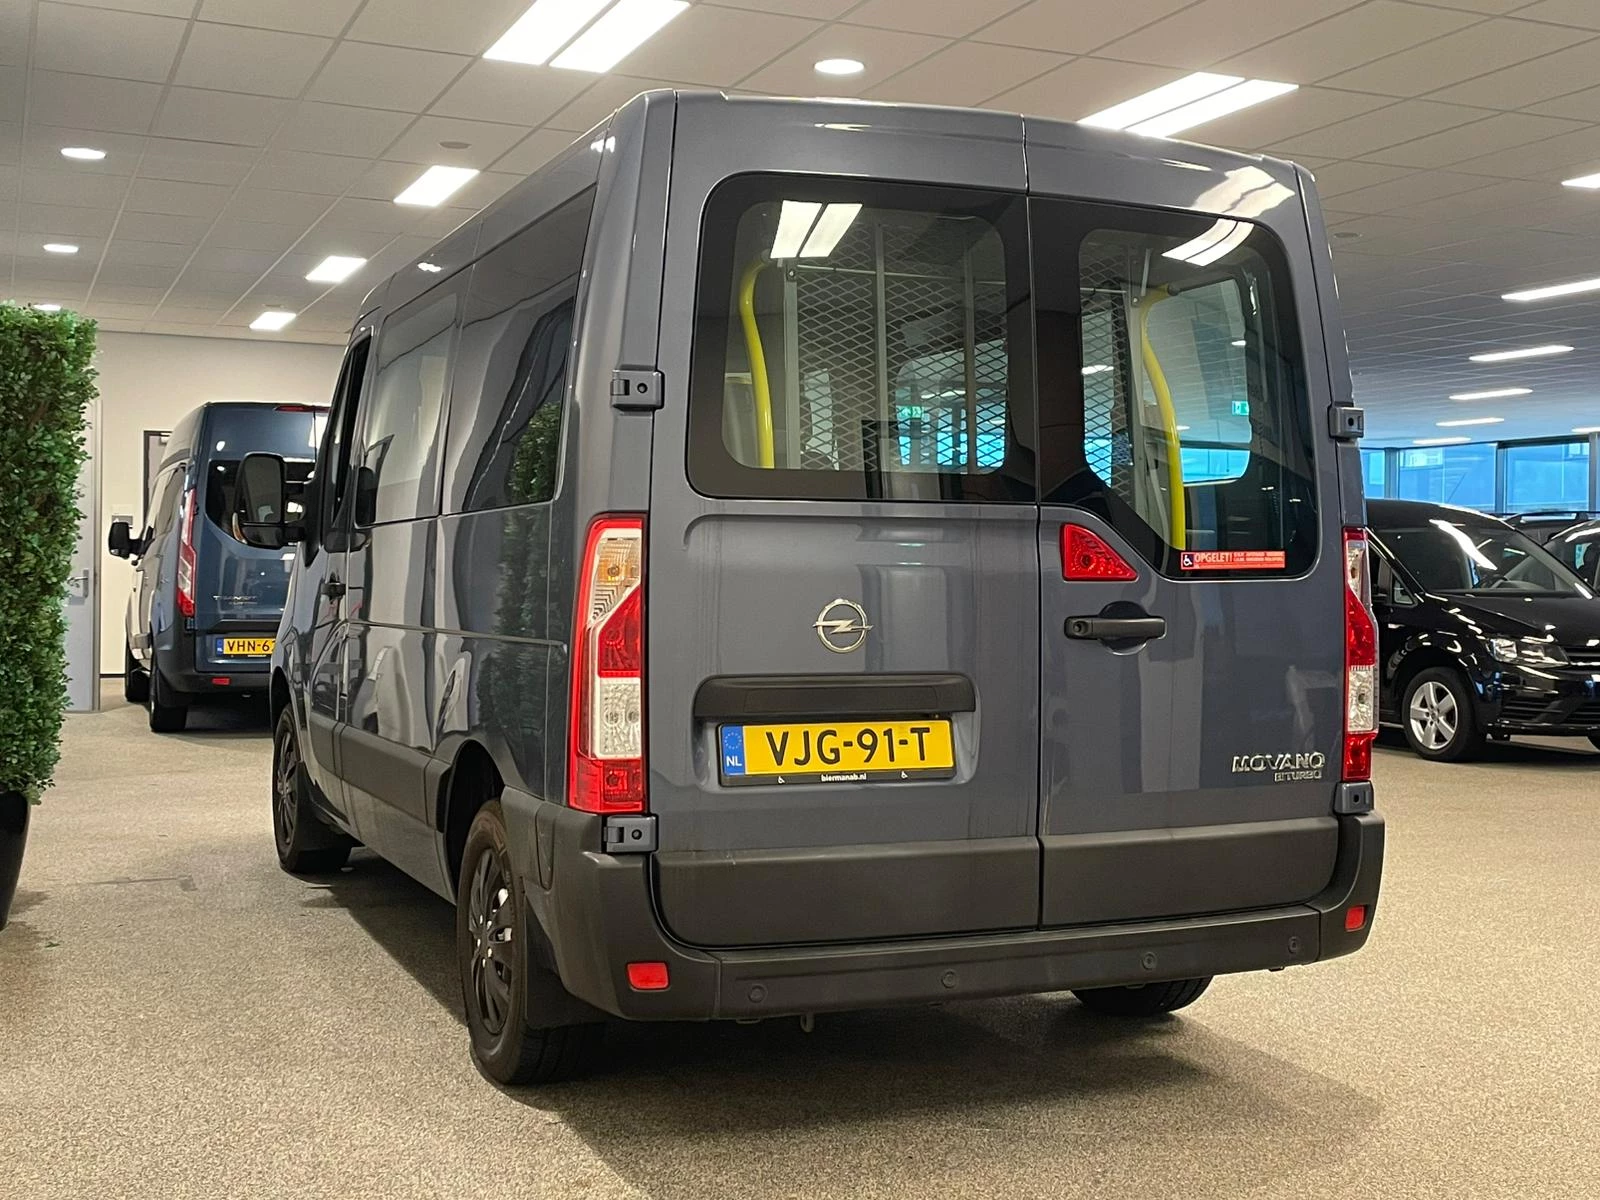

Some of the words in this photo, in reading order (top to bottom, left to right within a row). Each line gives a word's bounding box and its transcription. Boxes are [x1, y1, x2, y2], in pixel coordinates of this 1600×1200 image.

[1194, 552, 1233, 563] OPGELET!
[766, 727, 930, 766] VJG-91-T
[726, 755, 742, 767] NL
[1231, 751, 1326, 773] MOVANO
[820, 772, 867, 782] biermanab.nl
